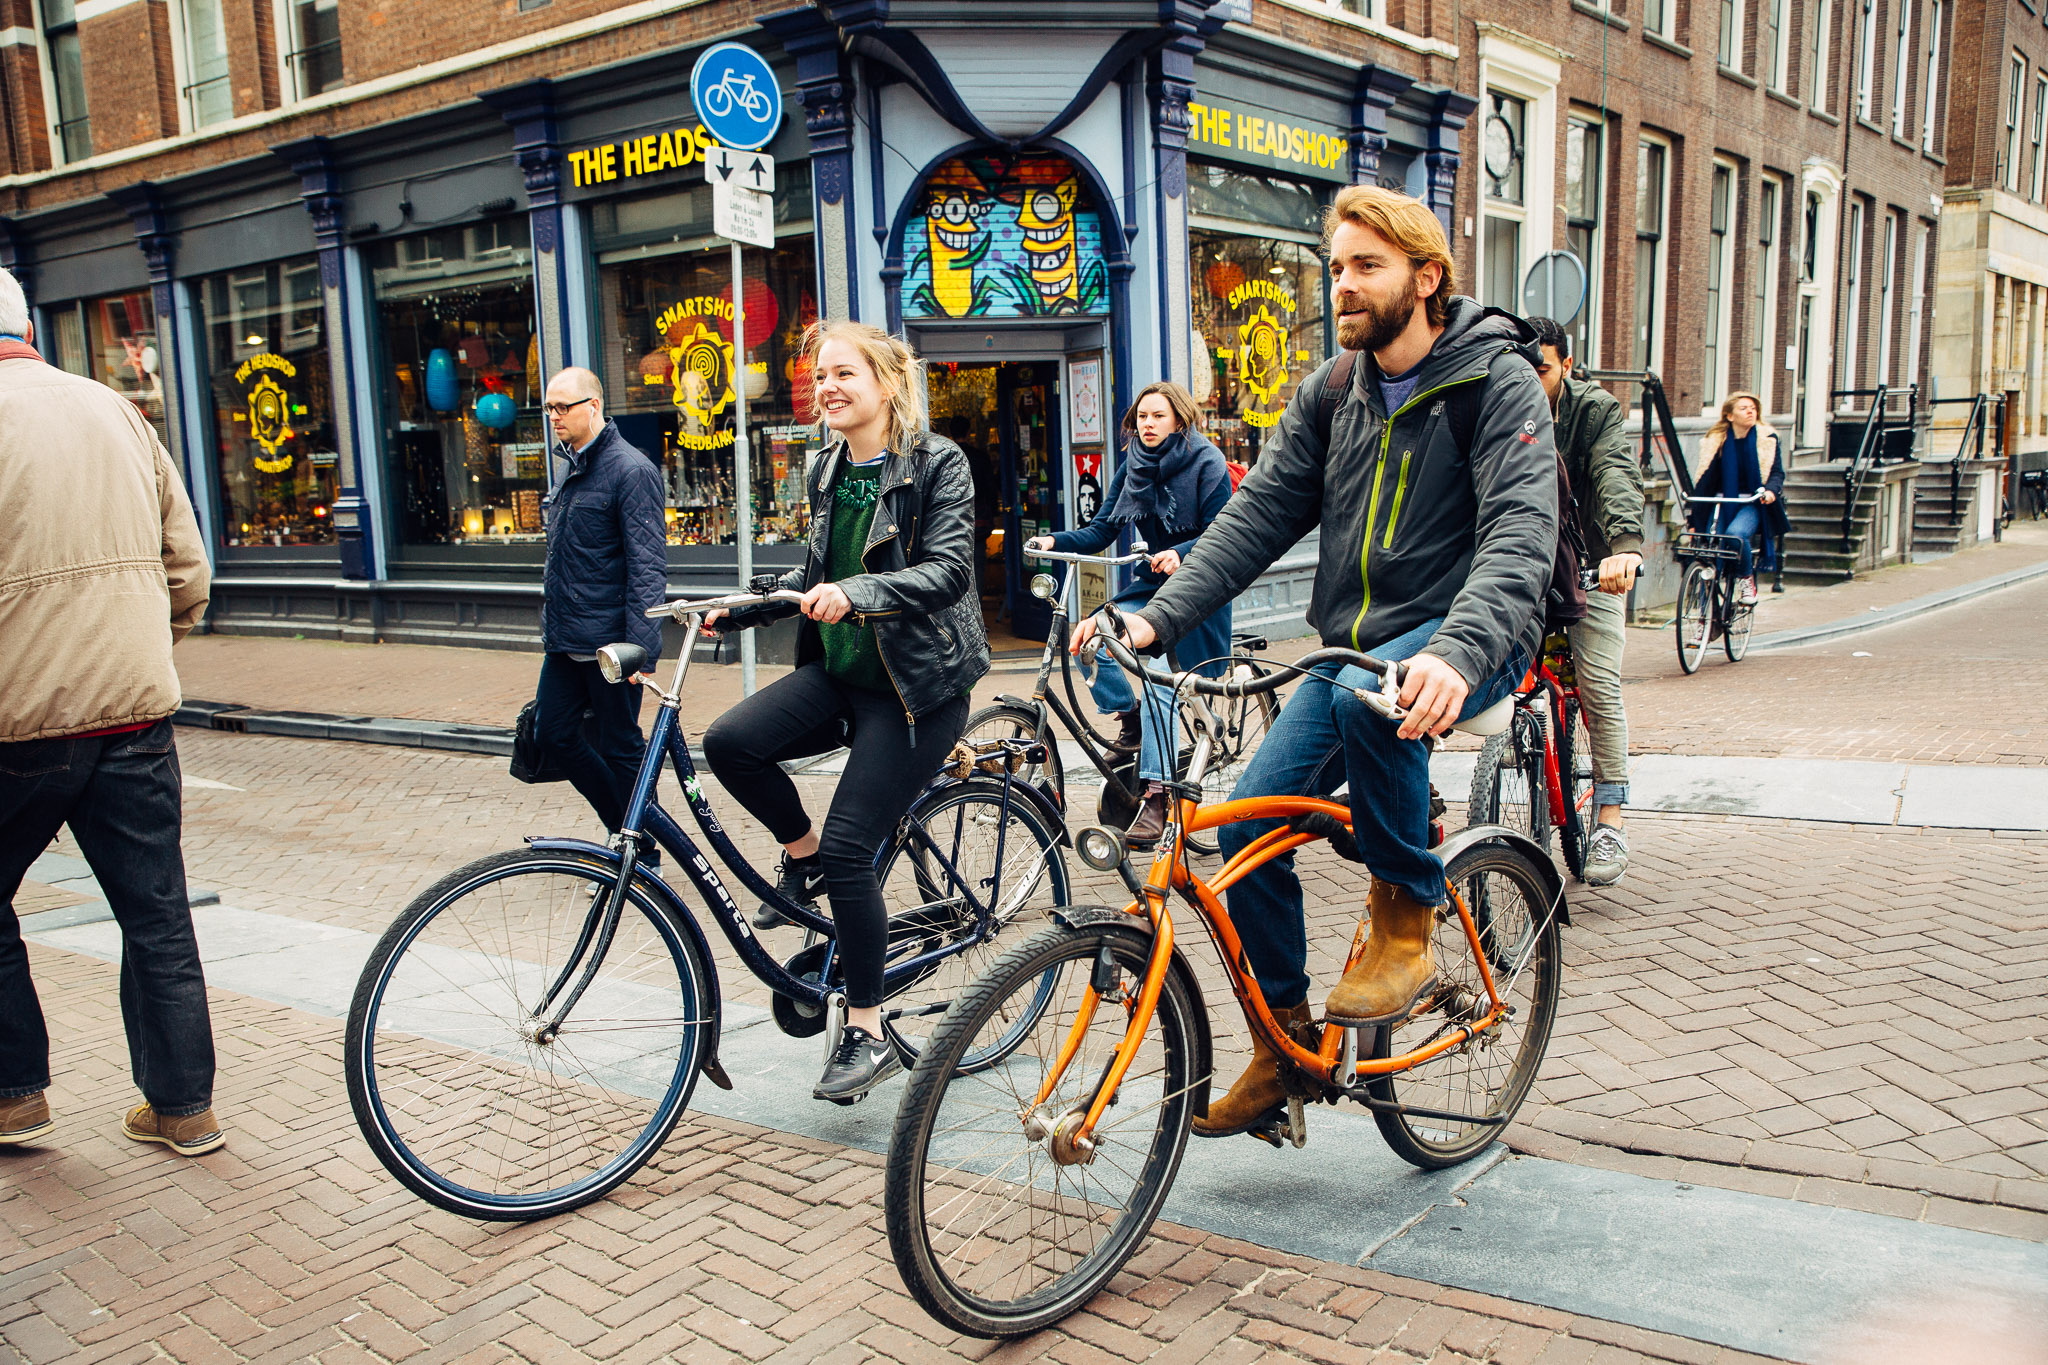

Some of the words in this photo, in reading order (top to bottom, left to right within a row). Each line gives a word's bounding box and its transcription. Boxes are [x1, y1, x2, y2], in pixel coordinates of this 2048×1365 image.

[1187, 101, 1231, 147] THE
[568, 144, 617, 187] THE
[1228, 280, 1296, 312] SMARTSHOP
[643, 373, 664, 386] Since
[749, 362, 768, 374] 1968
[1081, 365, 1097, 375] HEAD
[1242, 407, 1285, 428] SEEDBAN
[676, 428, 735, 450] SEEDBANK
[692, 853, 751, 939] Sparta
[1268, 1016, 1295, 1050] Sparta
